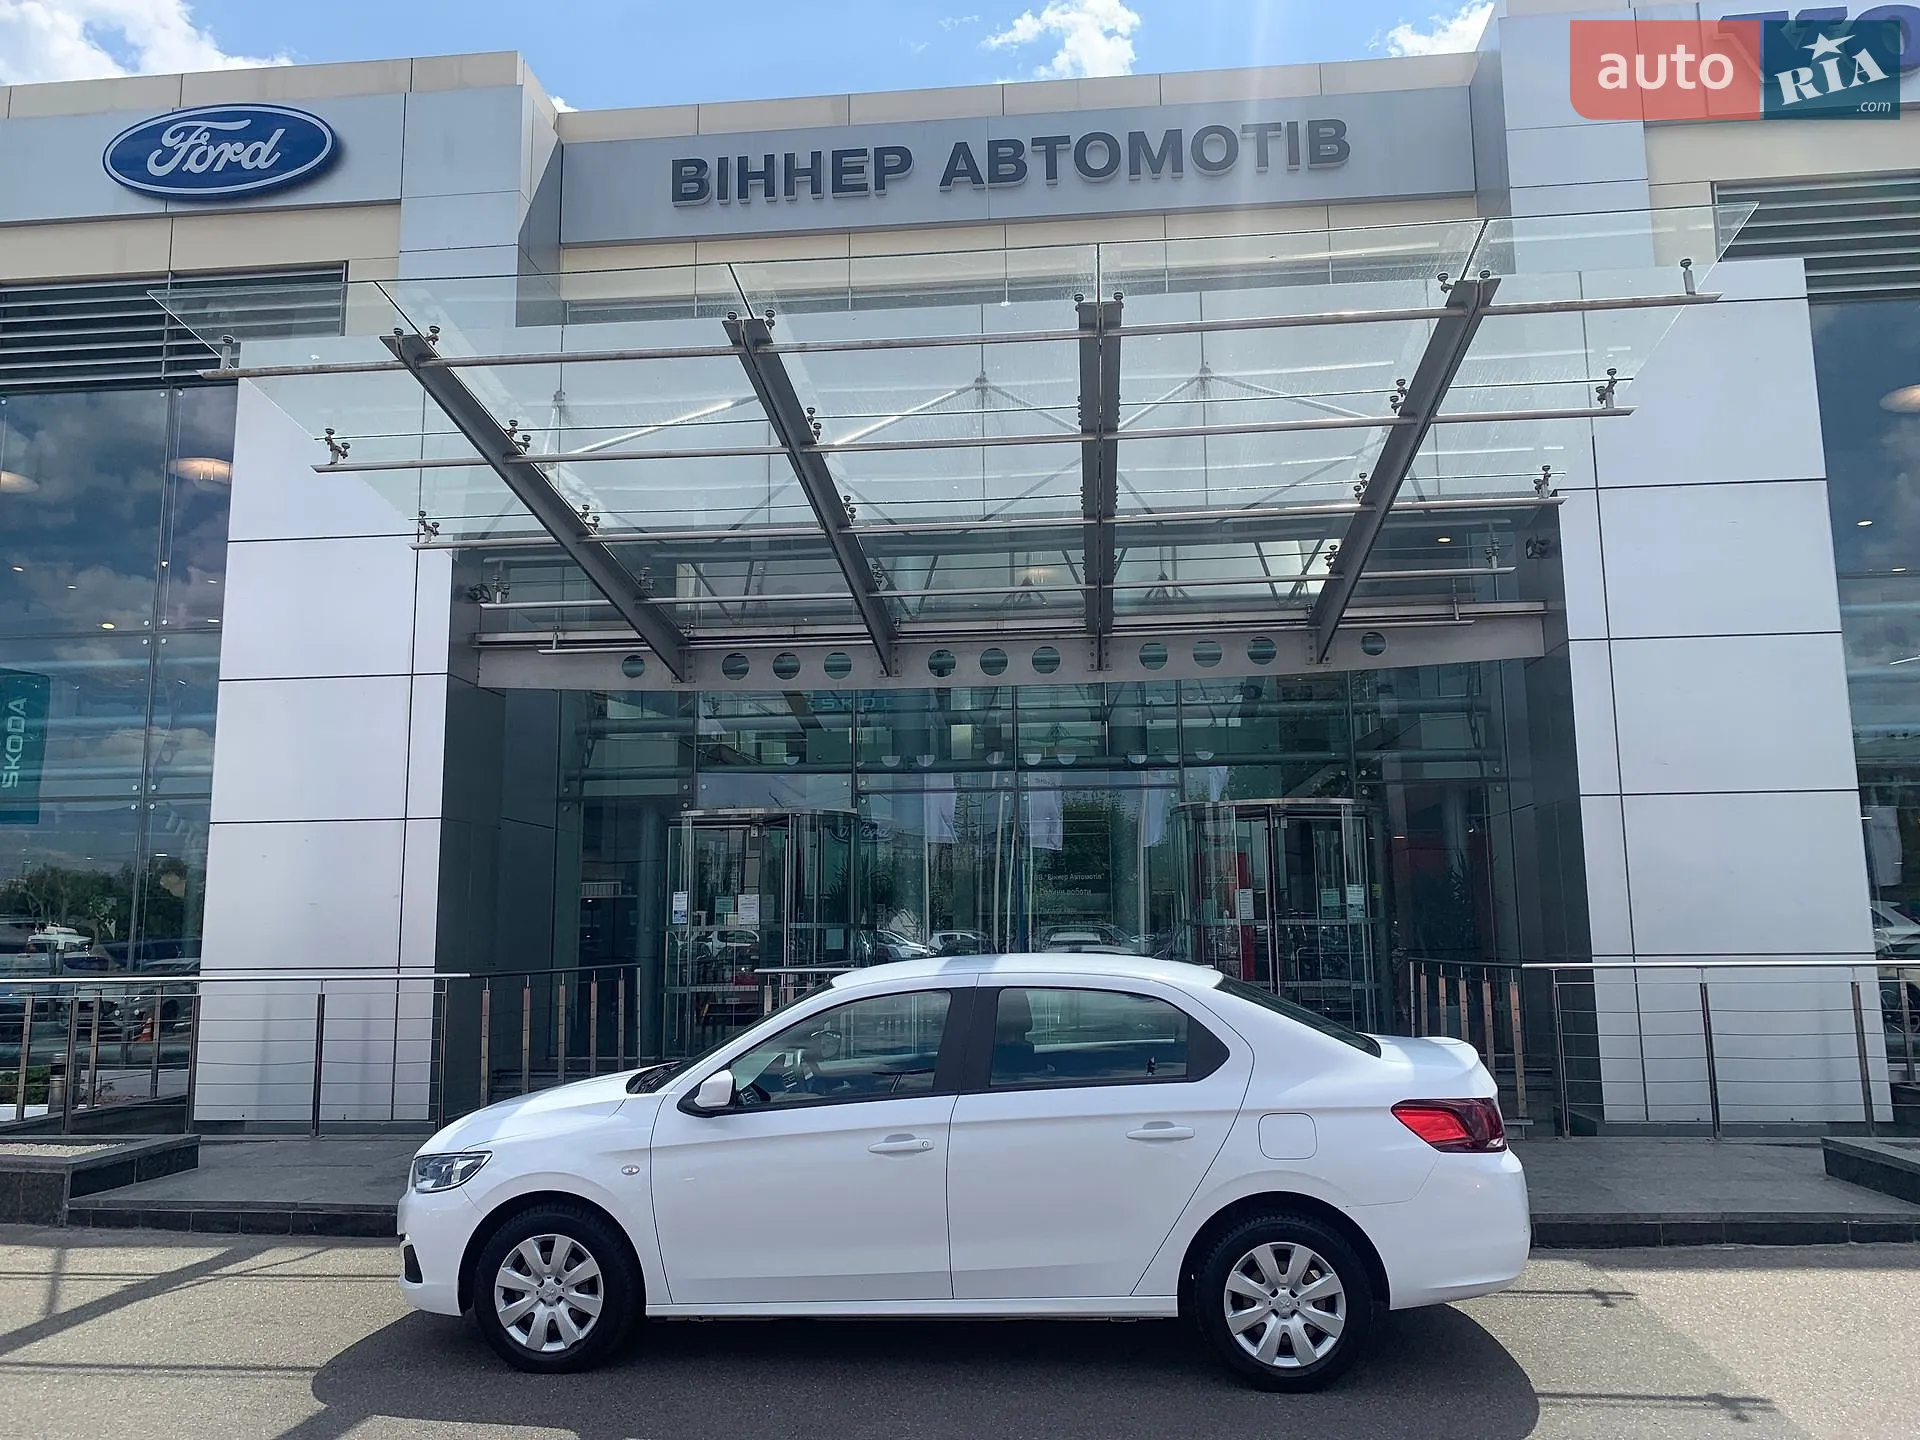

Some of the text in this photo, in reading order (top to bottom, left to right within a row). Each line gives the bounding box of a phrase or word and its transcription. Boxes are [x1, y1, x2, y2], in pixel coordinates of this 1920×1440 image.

[147, 119, 286, 177] Ford
[671, 117, 1352, 207] ВІННЕР АВТОМОТІВ
